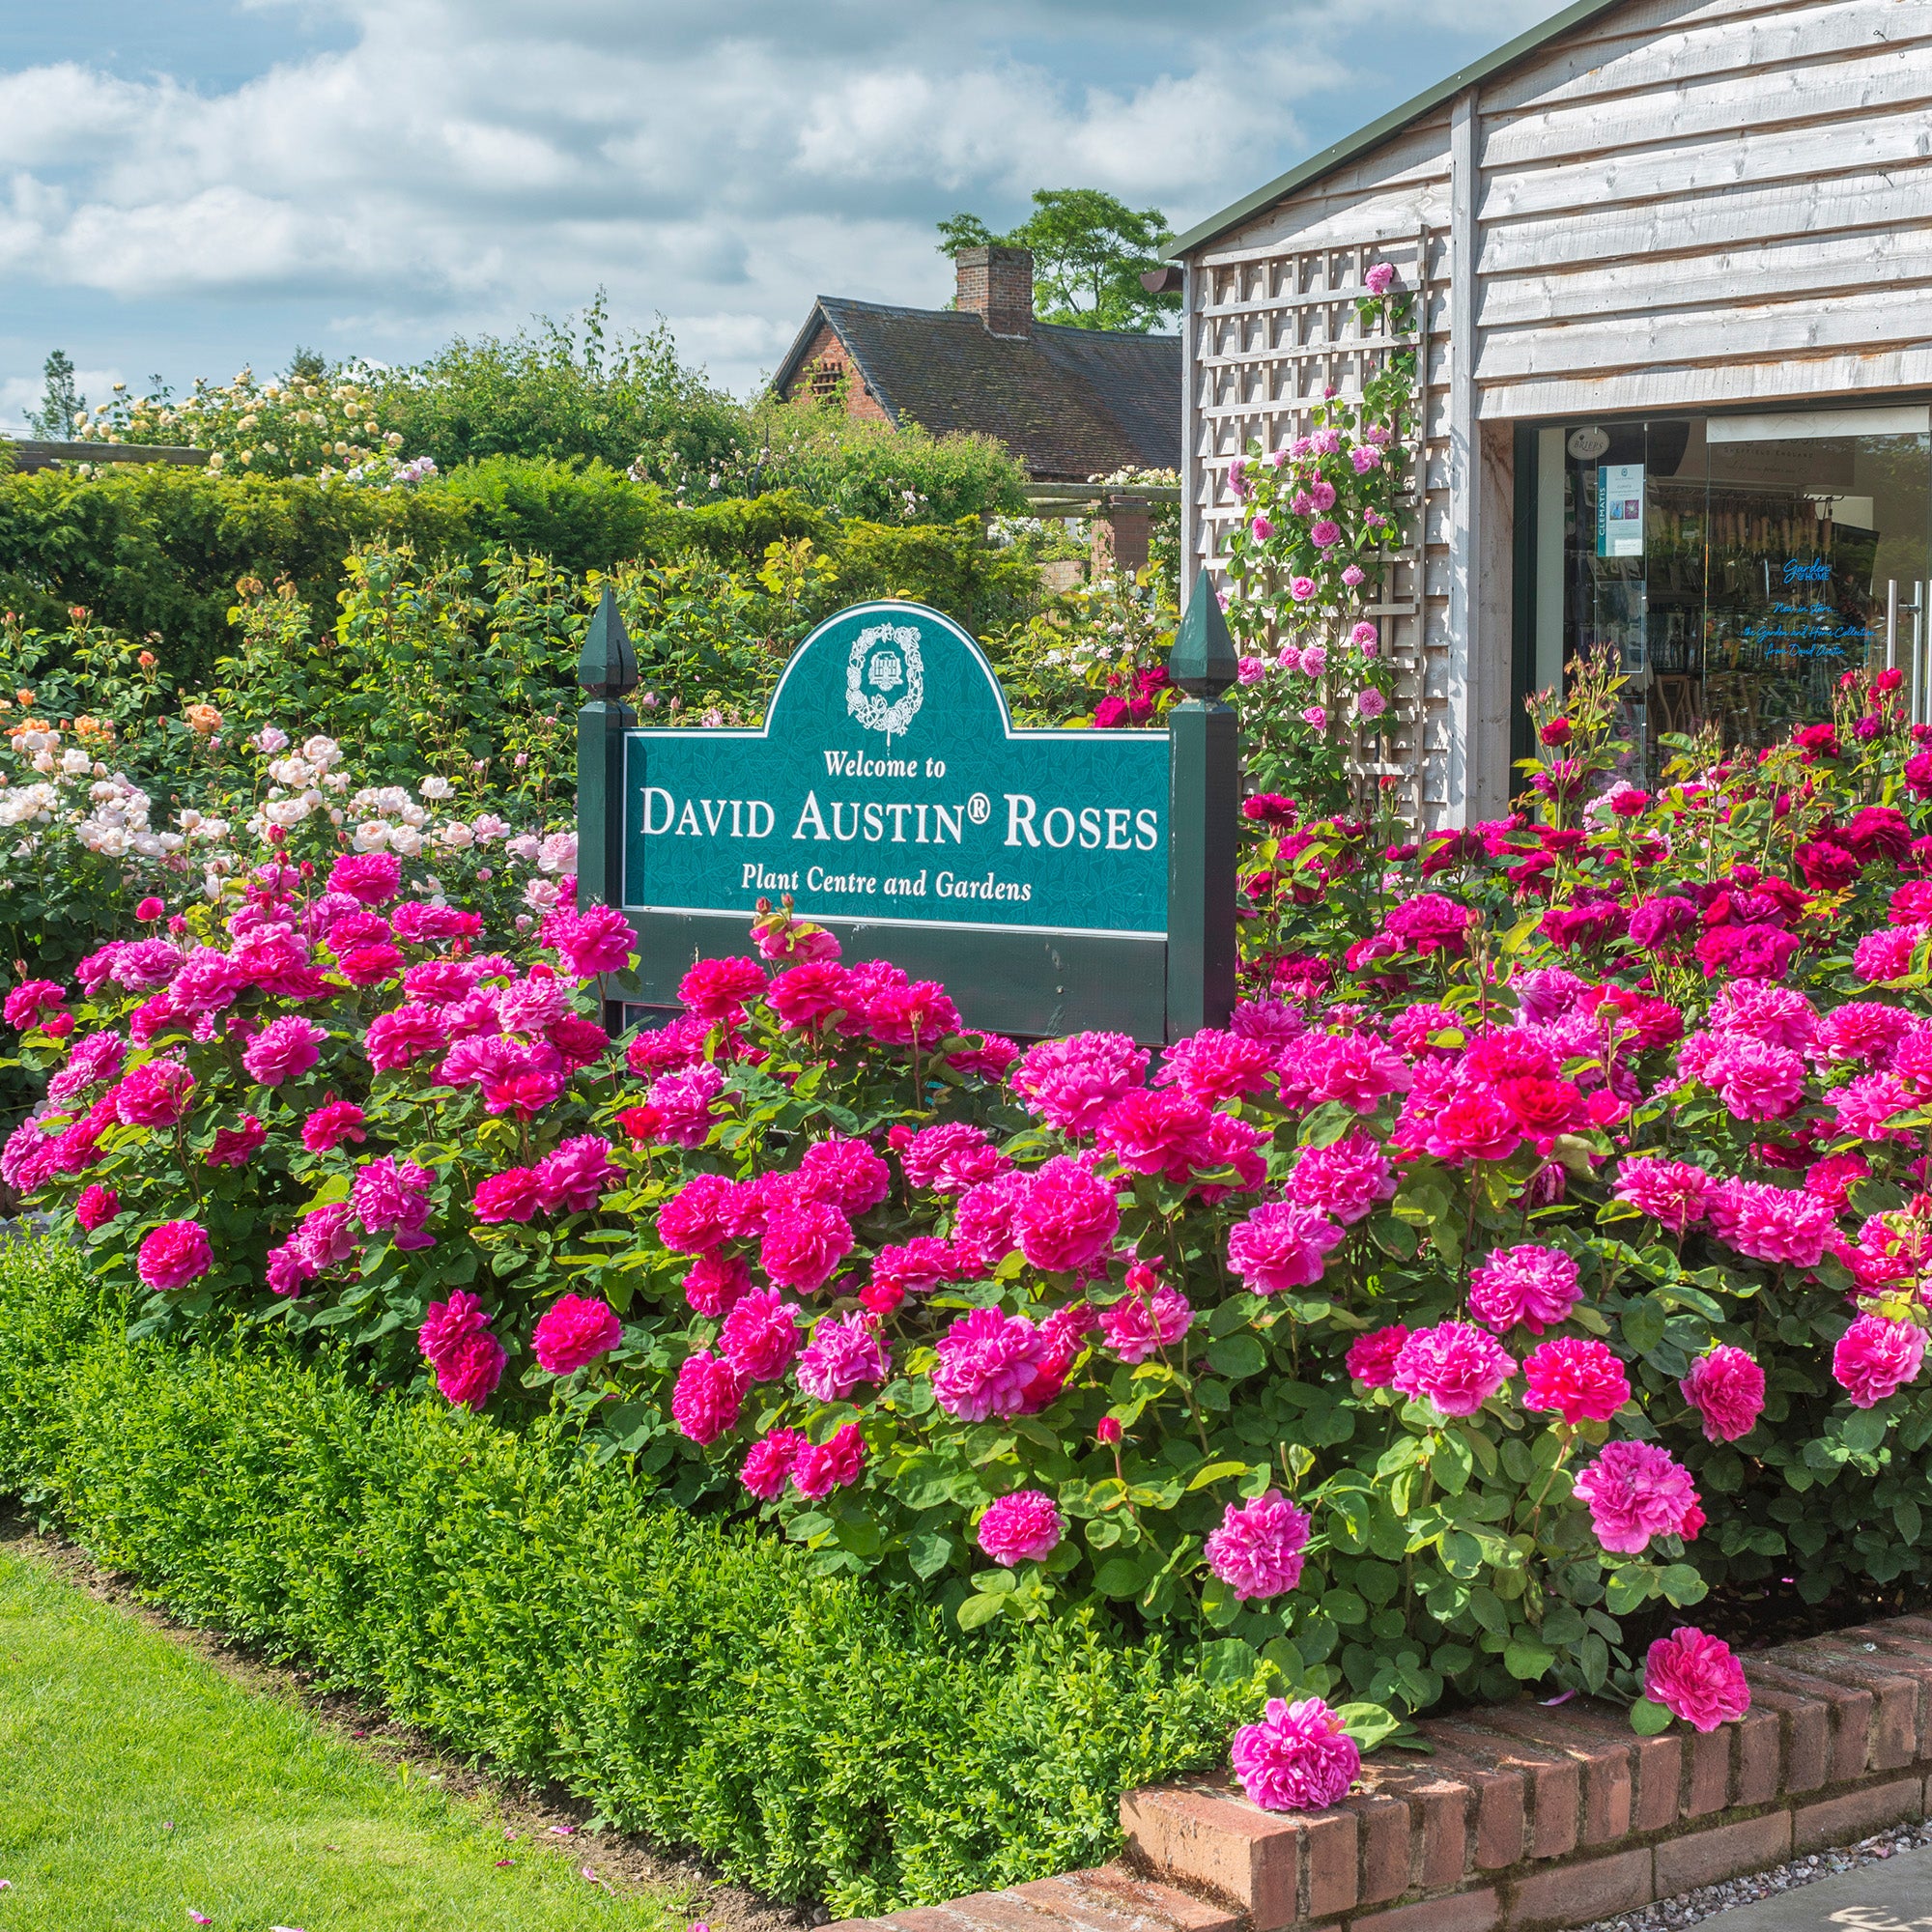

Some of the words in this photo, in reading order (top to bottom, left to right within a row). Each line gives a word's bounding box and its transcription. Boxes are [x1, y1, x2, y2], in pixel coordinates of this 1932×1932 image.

[1783, 557, 1832, 583] Garden
[1804, 572, 1830, 581] HOME
[1797, 603, 1808, 613] in
[1756, 624, 1788, 643] Garden
[1790, 625, 1809, 637] and
[1809, 625, 1833, 640] Home
[1833, 625, 1877, 638] Collection
[1764, 642, 1788, 660] from
[1789, 642, 1816, 657] David
[1816, 644, 1846, 657] Austin
[824, 750, 918, 779] Welcome
[924, 756, 947, 779] to
[639, 786, 776, 838] DAVID
[1003, 793, 1158, 851] ROSES
[741, 863, 799, 892] Plant
[806, 866, 877, 895] Centre
[883, 868, 927, 897] and
[935, 870, 1032, 902] Gardens
